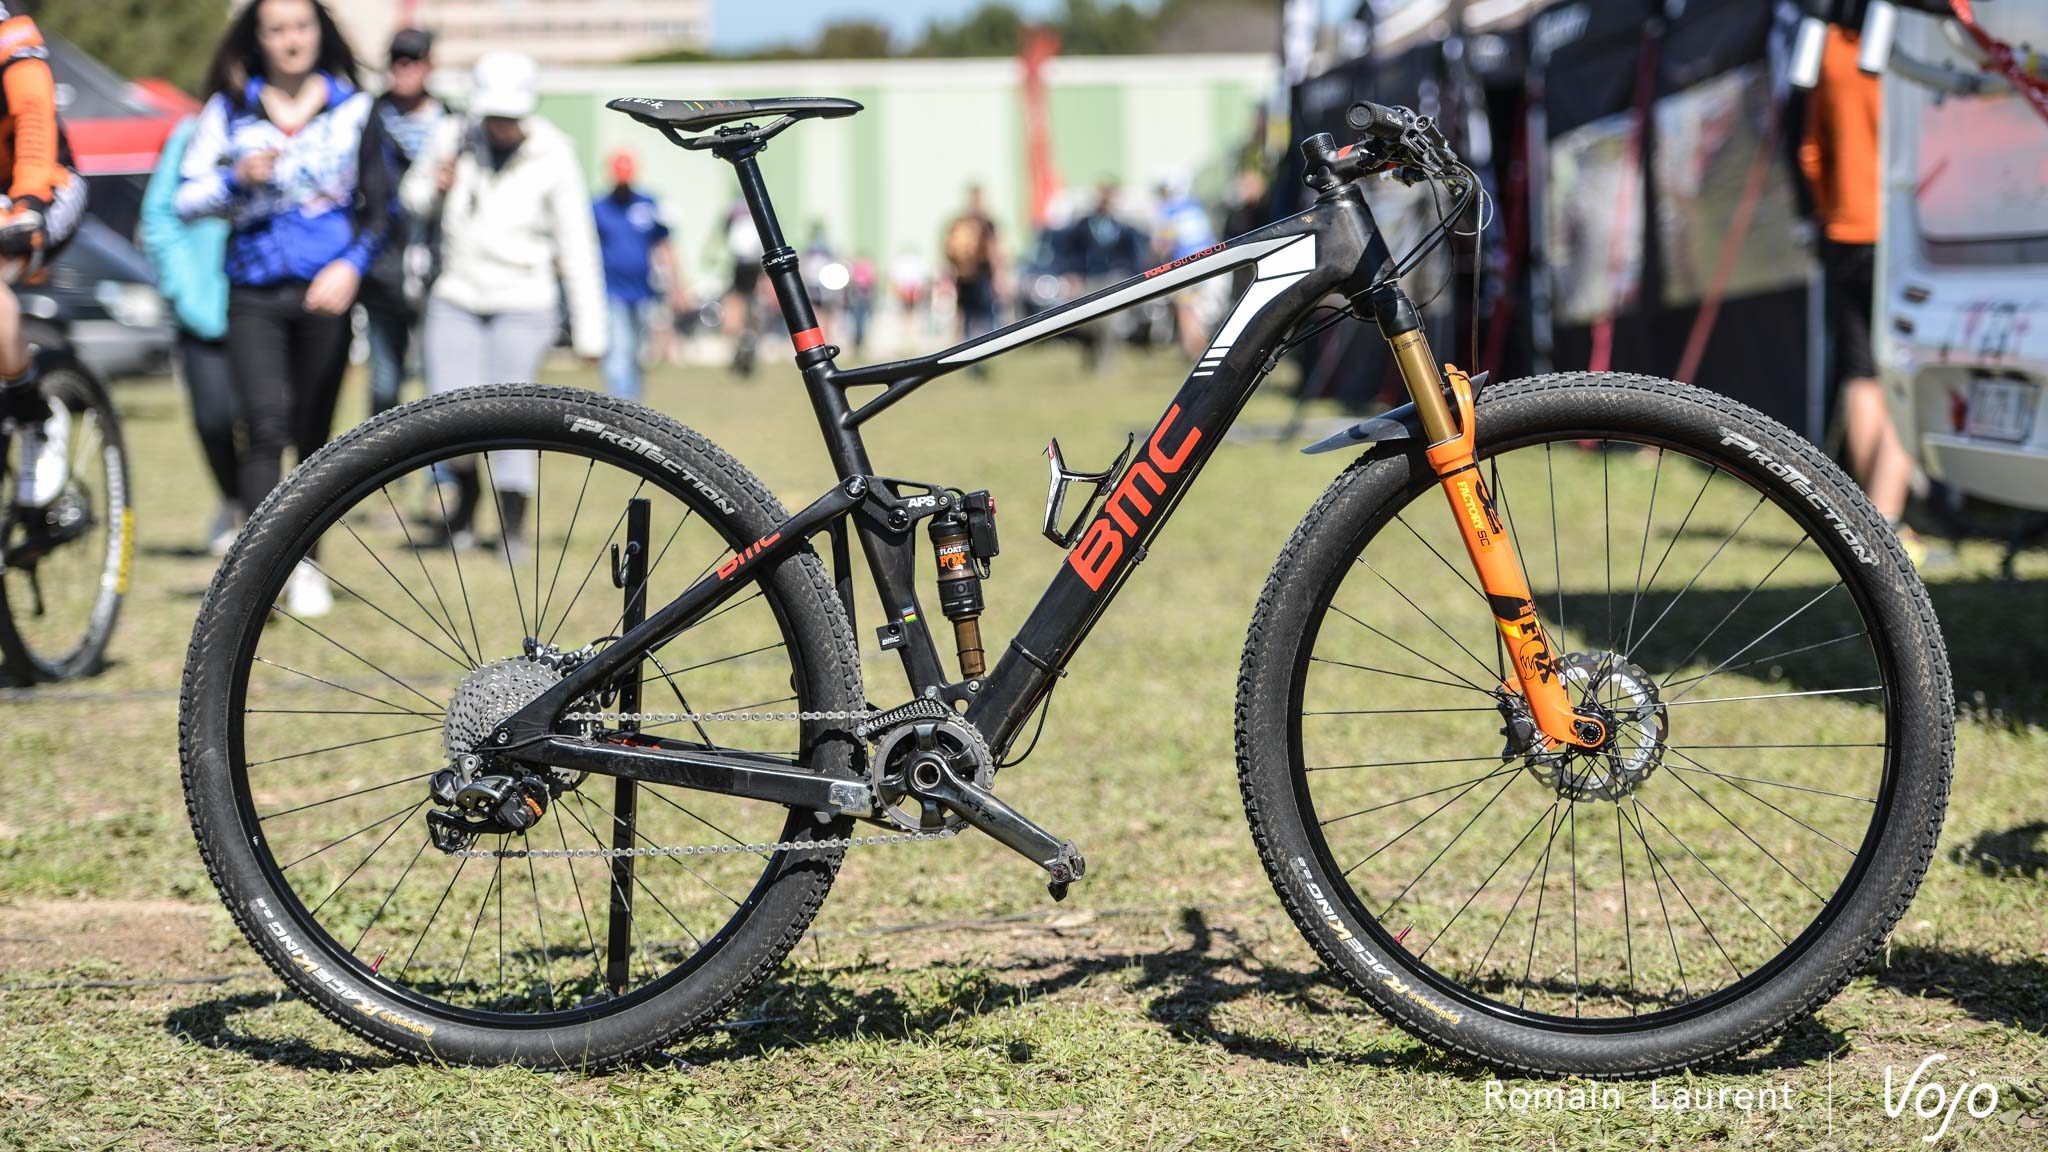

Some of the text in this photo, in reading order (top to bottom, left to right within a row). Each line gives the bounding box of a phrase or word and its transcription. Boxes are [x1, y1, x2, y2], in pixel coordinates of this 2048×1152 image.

[569, 416, 735, 516] PROTECTION
[908, 496, 935, 507] APS
[1069, 403, 1202, 592] BMC
[1457, 480, 1484, 530] FACTORY
[1477, 530, 1490, 547] SC
[1720, 432, 1880, 567] PROTECTION
[717, 533, 781, 581] BMC
[939, 546, 962, 556] FLOAT
[939, 552, 967, 571] FOX
[882, 635, 900, 646] BMC
[1520, 620, 1558, 684] FOX
